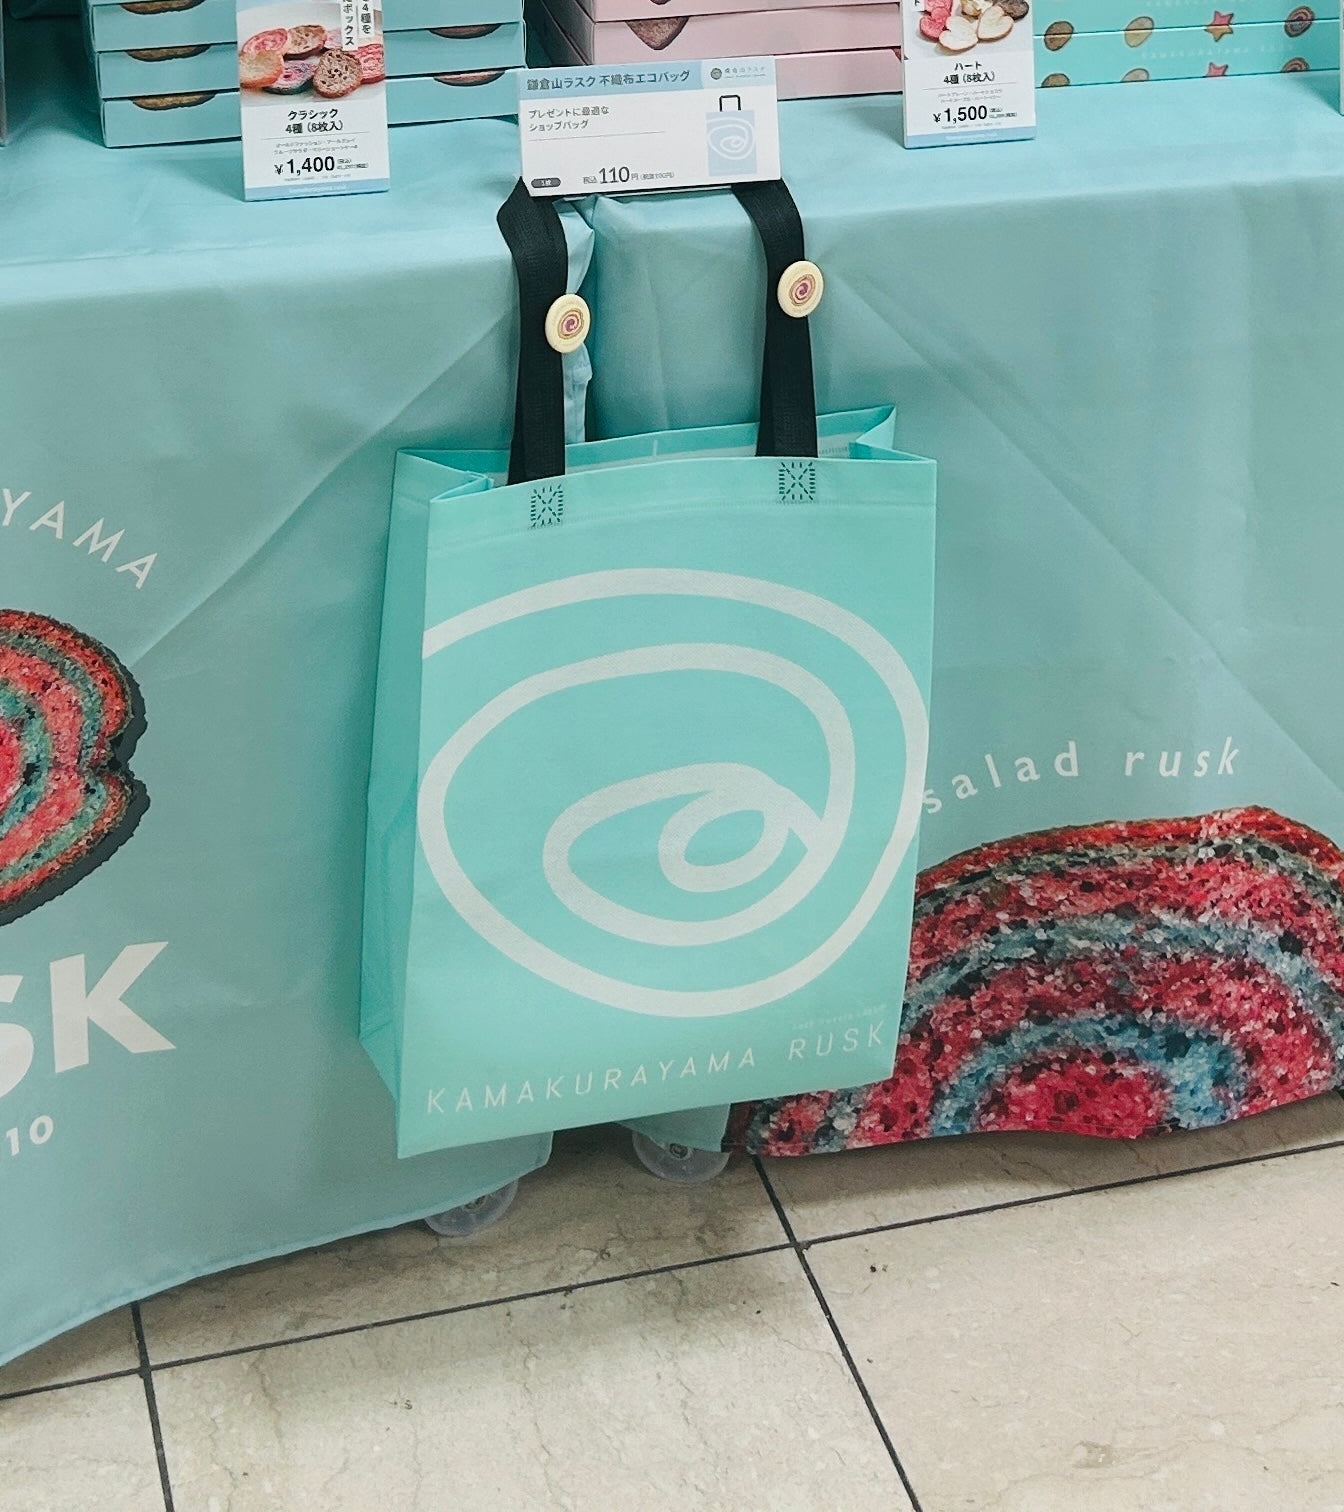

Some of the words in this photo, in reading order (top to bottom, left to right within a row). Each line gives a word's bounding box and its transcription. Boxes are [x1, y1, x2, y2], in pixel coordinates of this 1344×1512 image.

[954, 61, 982, 72] ハート
[288, 108, 338, 121] クラシック
[933, 105, 988, 124] ¥1,500
[529, 119, 589, 132] ショップバッグ
[274, 155, 335, 175] ¥1,400
[921, 740, 1080, 815] salad
[1124, 735, 1240, 778] rusk
[425, 1044, 758, 1116] KAMAKURAYAMA
[788, 1019, 885, 1061] RUSK
